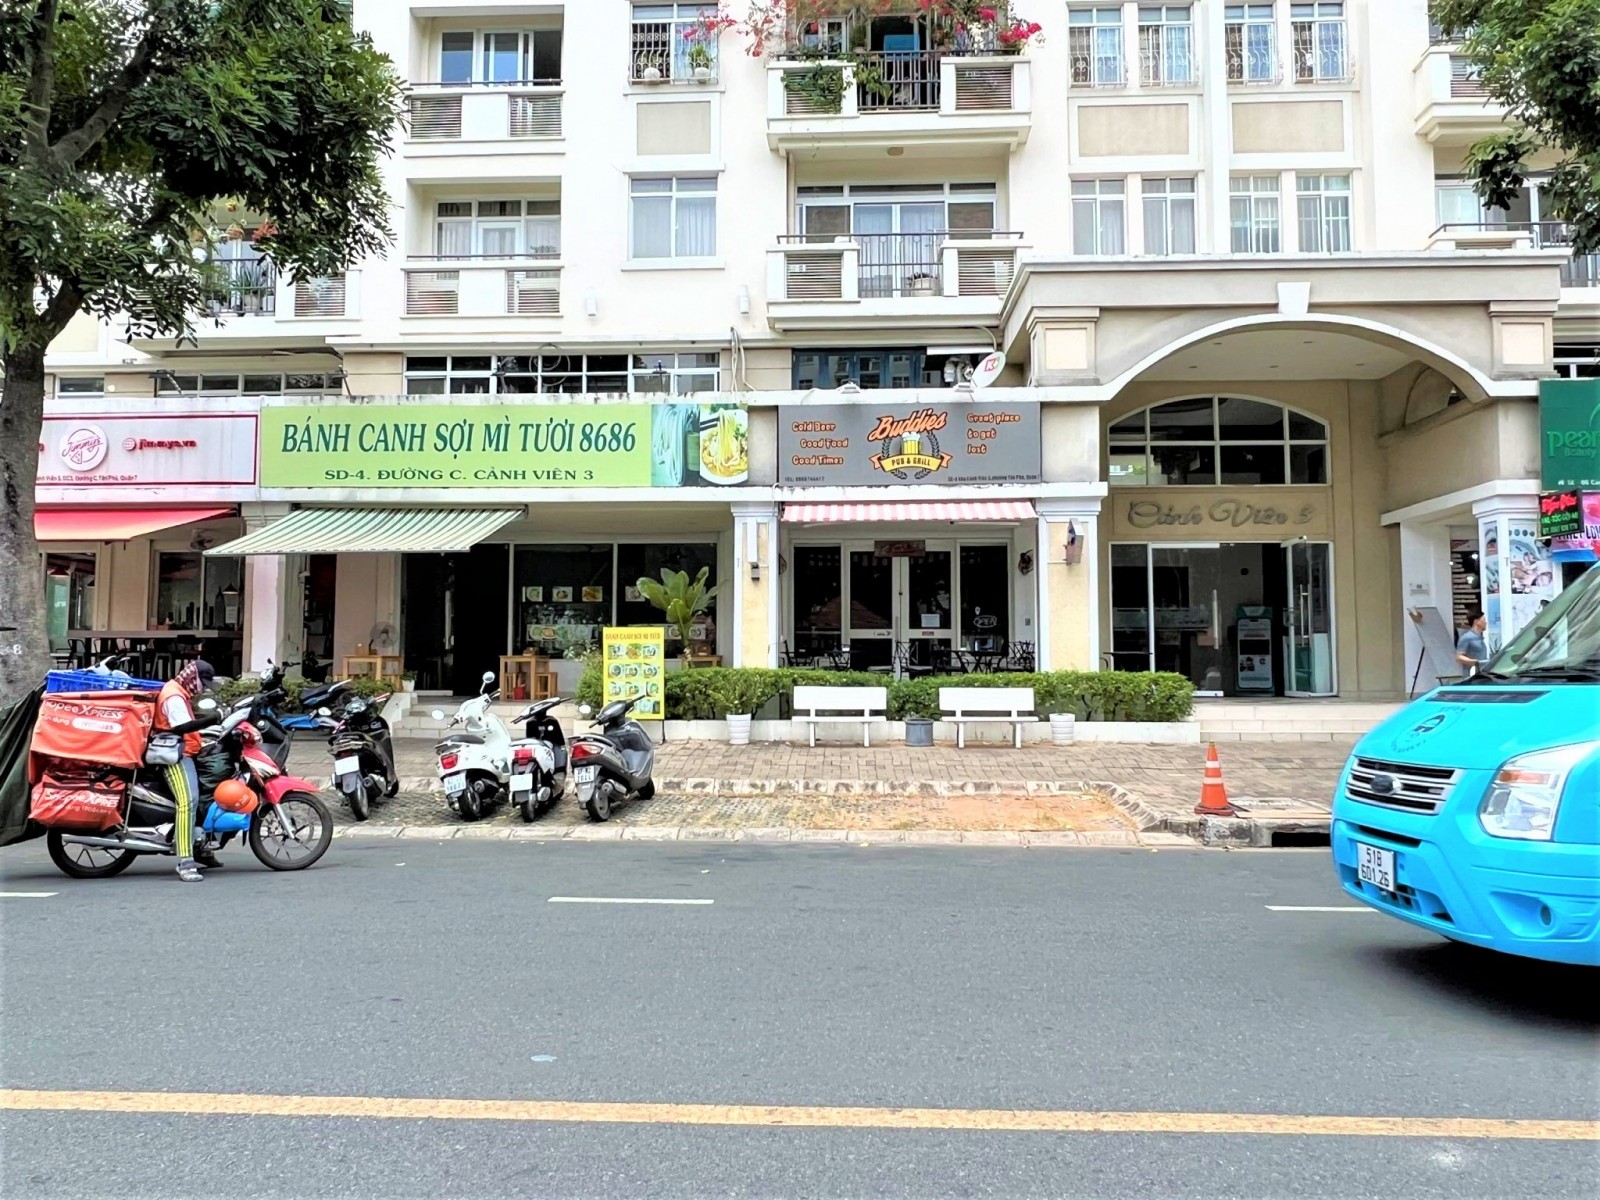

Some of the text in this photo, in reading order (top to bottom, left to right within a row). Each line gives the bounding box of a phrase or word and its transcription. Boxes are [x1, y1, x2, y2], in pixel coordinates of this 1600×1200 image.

[967, 412, 1021, 424] Great place
[792, 421, 836, 432] Cold Beer
[867, 407, 948, 443] Buddies
[281, 415, 636, 460] BÁNH CANH SỢI MÌ TƯƠI 8686
[967, 428, 996, 440] to get
[800, 437, 849, 449] Good Food
[967, 444, 987, 454] lost
[792, 454, 844, 466] Good Times
[891, 457, 905, 467] PUB
[906, 457, 911, 465] &
[325, 466, 594, 480] SD-4. ĐƯỜNG C. CẢNH VIÊN 3
[1366, 847, 1382, 867] 51B
[1361, 863, 1390, 888] 601.26
